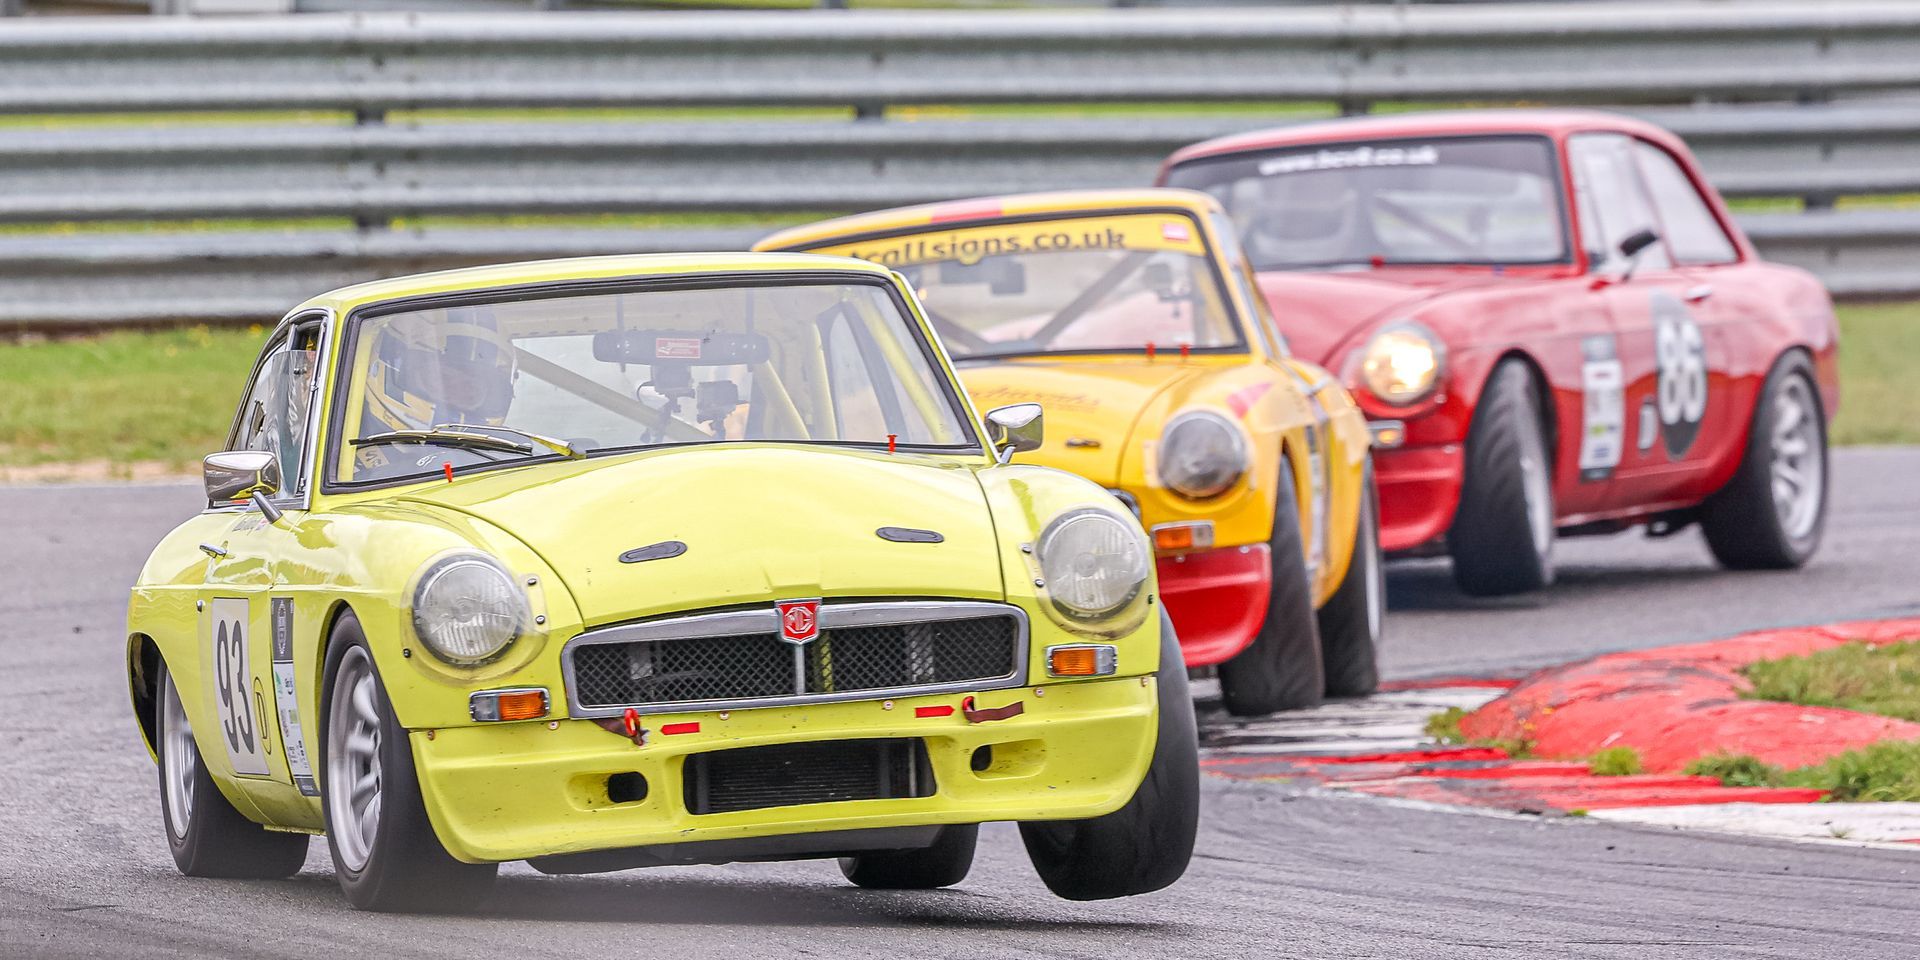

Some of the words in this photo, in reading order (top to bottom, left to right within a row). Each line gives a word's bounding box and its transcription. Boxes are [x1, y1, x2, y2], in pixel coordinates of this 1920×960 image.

[851, 229, 1124, 265] callsigns.co.uk
[1657, 317, 1707, 424] 86
[217, 619, 254, 754] 93
